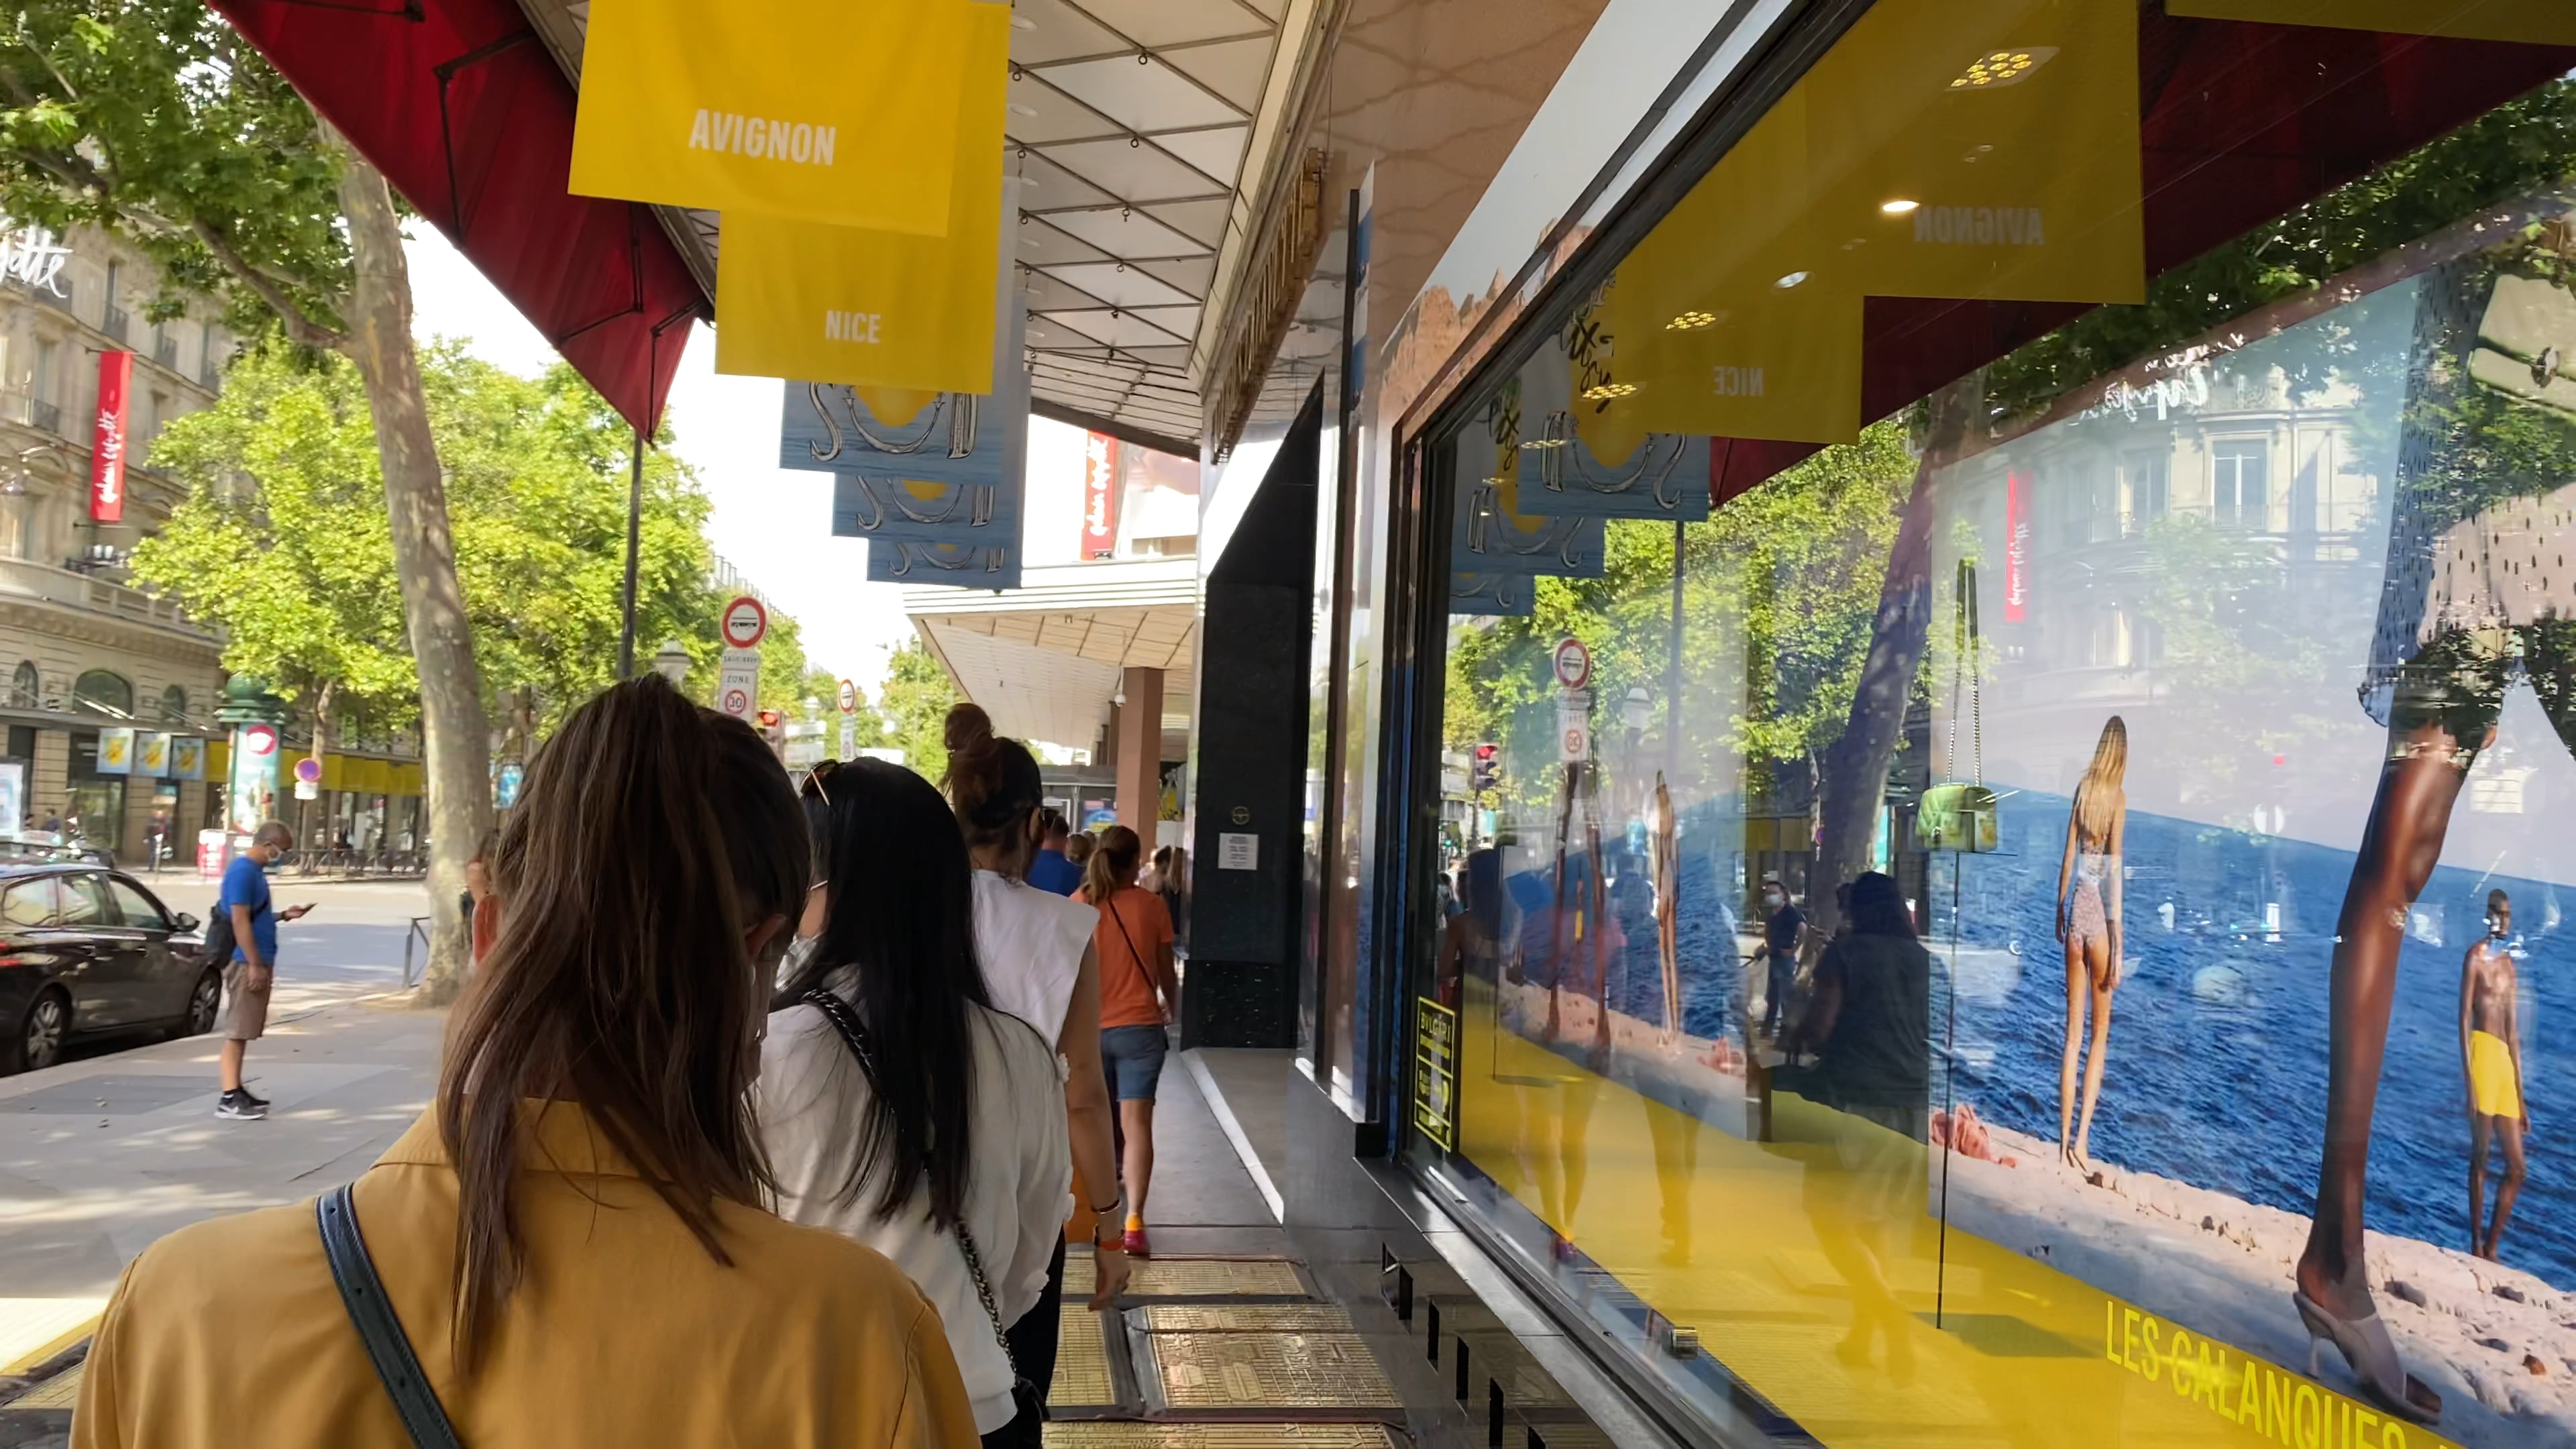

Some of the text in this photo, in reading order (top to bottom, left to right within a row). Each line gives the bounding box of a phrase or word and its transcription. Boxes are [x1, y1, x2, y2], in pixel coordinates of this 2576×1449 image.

[688, 108, 837, 166] AVIGNON
[826, 310, 881, 344] NICE
[727, 675, 749, 684] ZONE
[729, 697, 743, 708] 30
[1421, 1012, 1451, 1043] BVLGARI
[2106, 1300, 2159, 1381] LES
